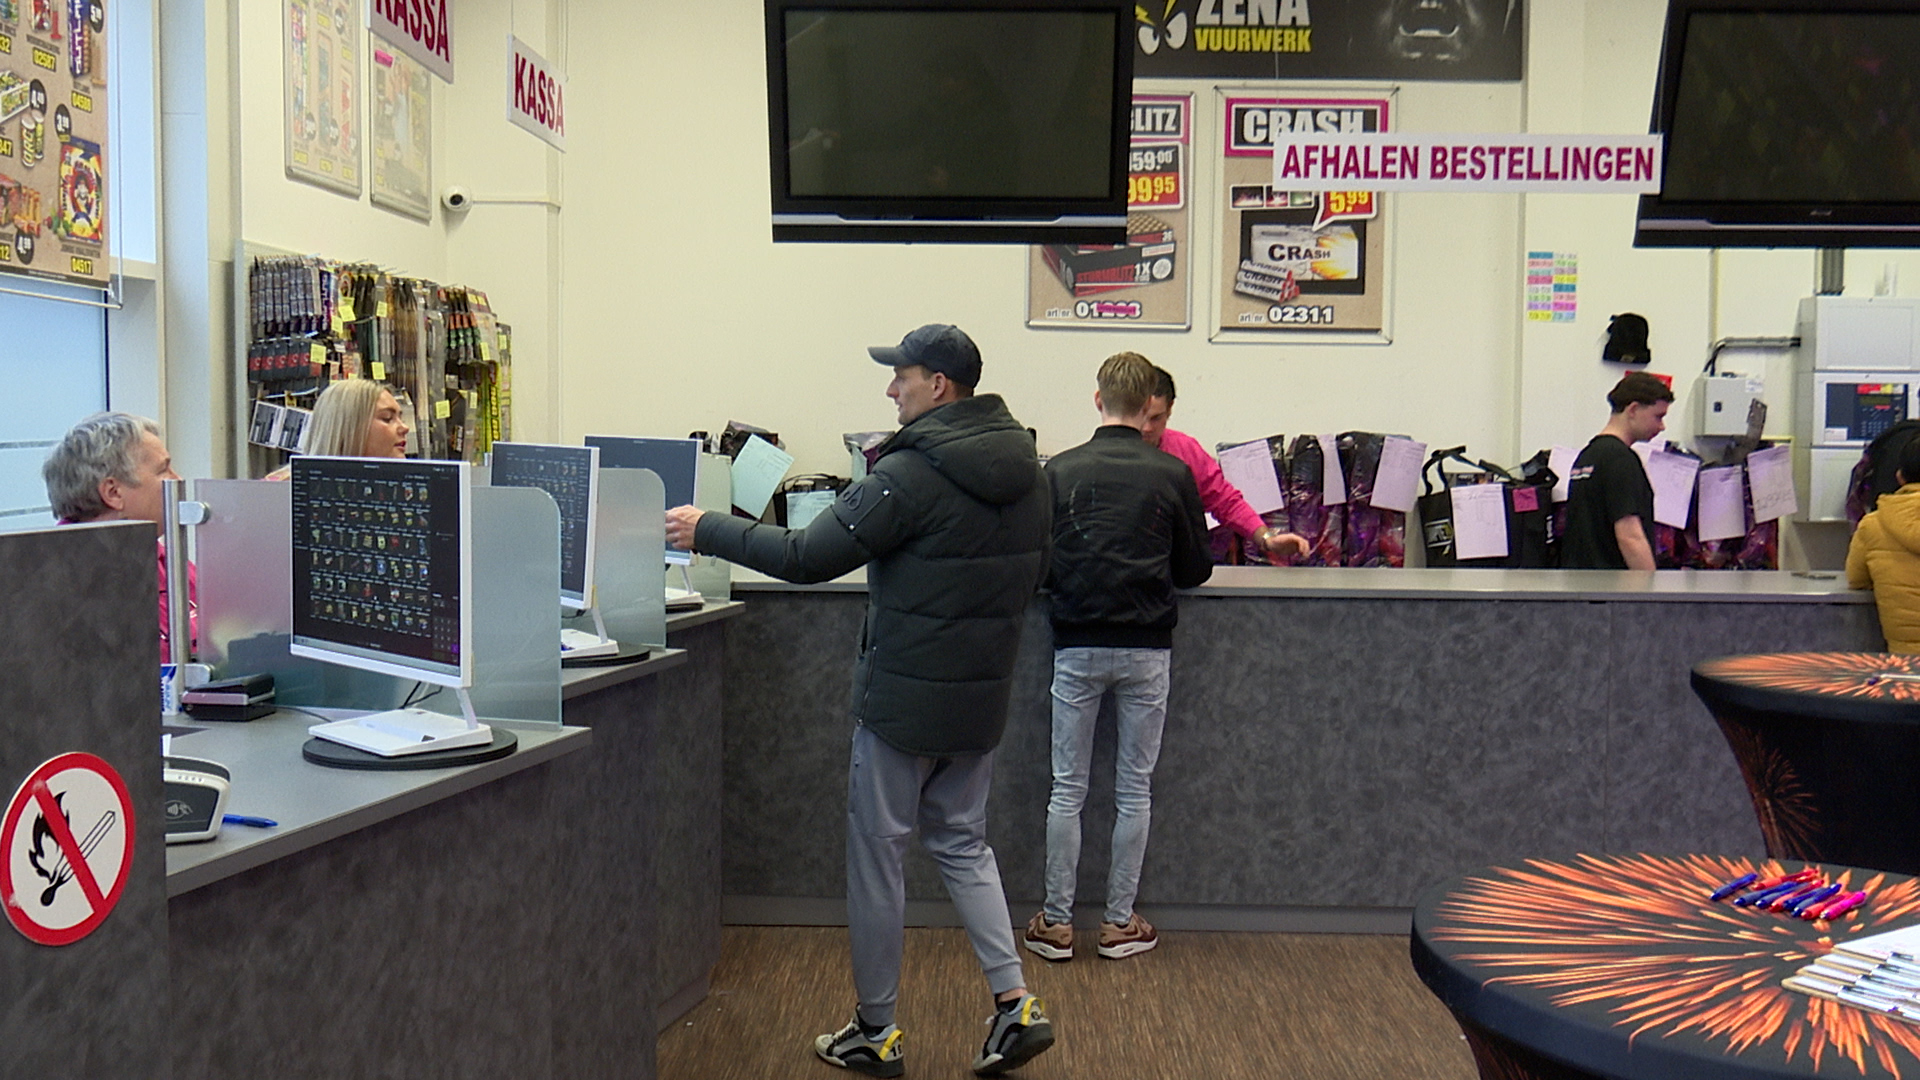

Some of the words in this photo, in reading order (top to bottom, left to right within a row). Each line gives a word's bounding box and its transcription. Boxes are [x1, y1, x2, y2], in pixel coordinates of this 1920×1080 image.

[1196, 0, 1310, 26] ZENA
[376, 0, 450, 63] SSA
[1194, 28, 1312, 52] VUURWERK
[514, 52, 565, 137] KASSA
[1131, 107, 1178, 132] LITZ
[1243, 109, 1364, 144] CRASH
[1281, 144, 1420, 180] AFHALEN
[1429, 145, 1654, 182] BESTELLINGEN
[1329, 191, 1370, 213] 5.99
[1268, 243, 1331, 262] CRASH
[1268, 305, 1333, 323] 02311
